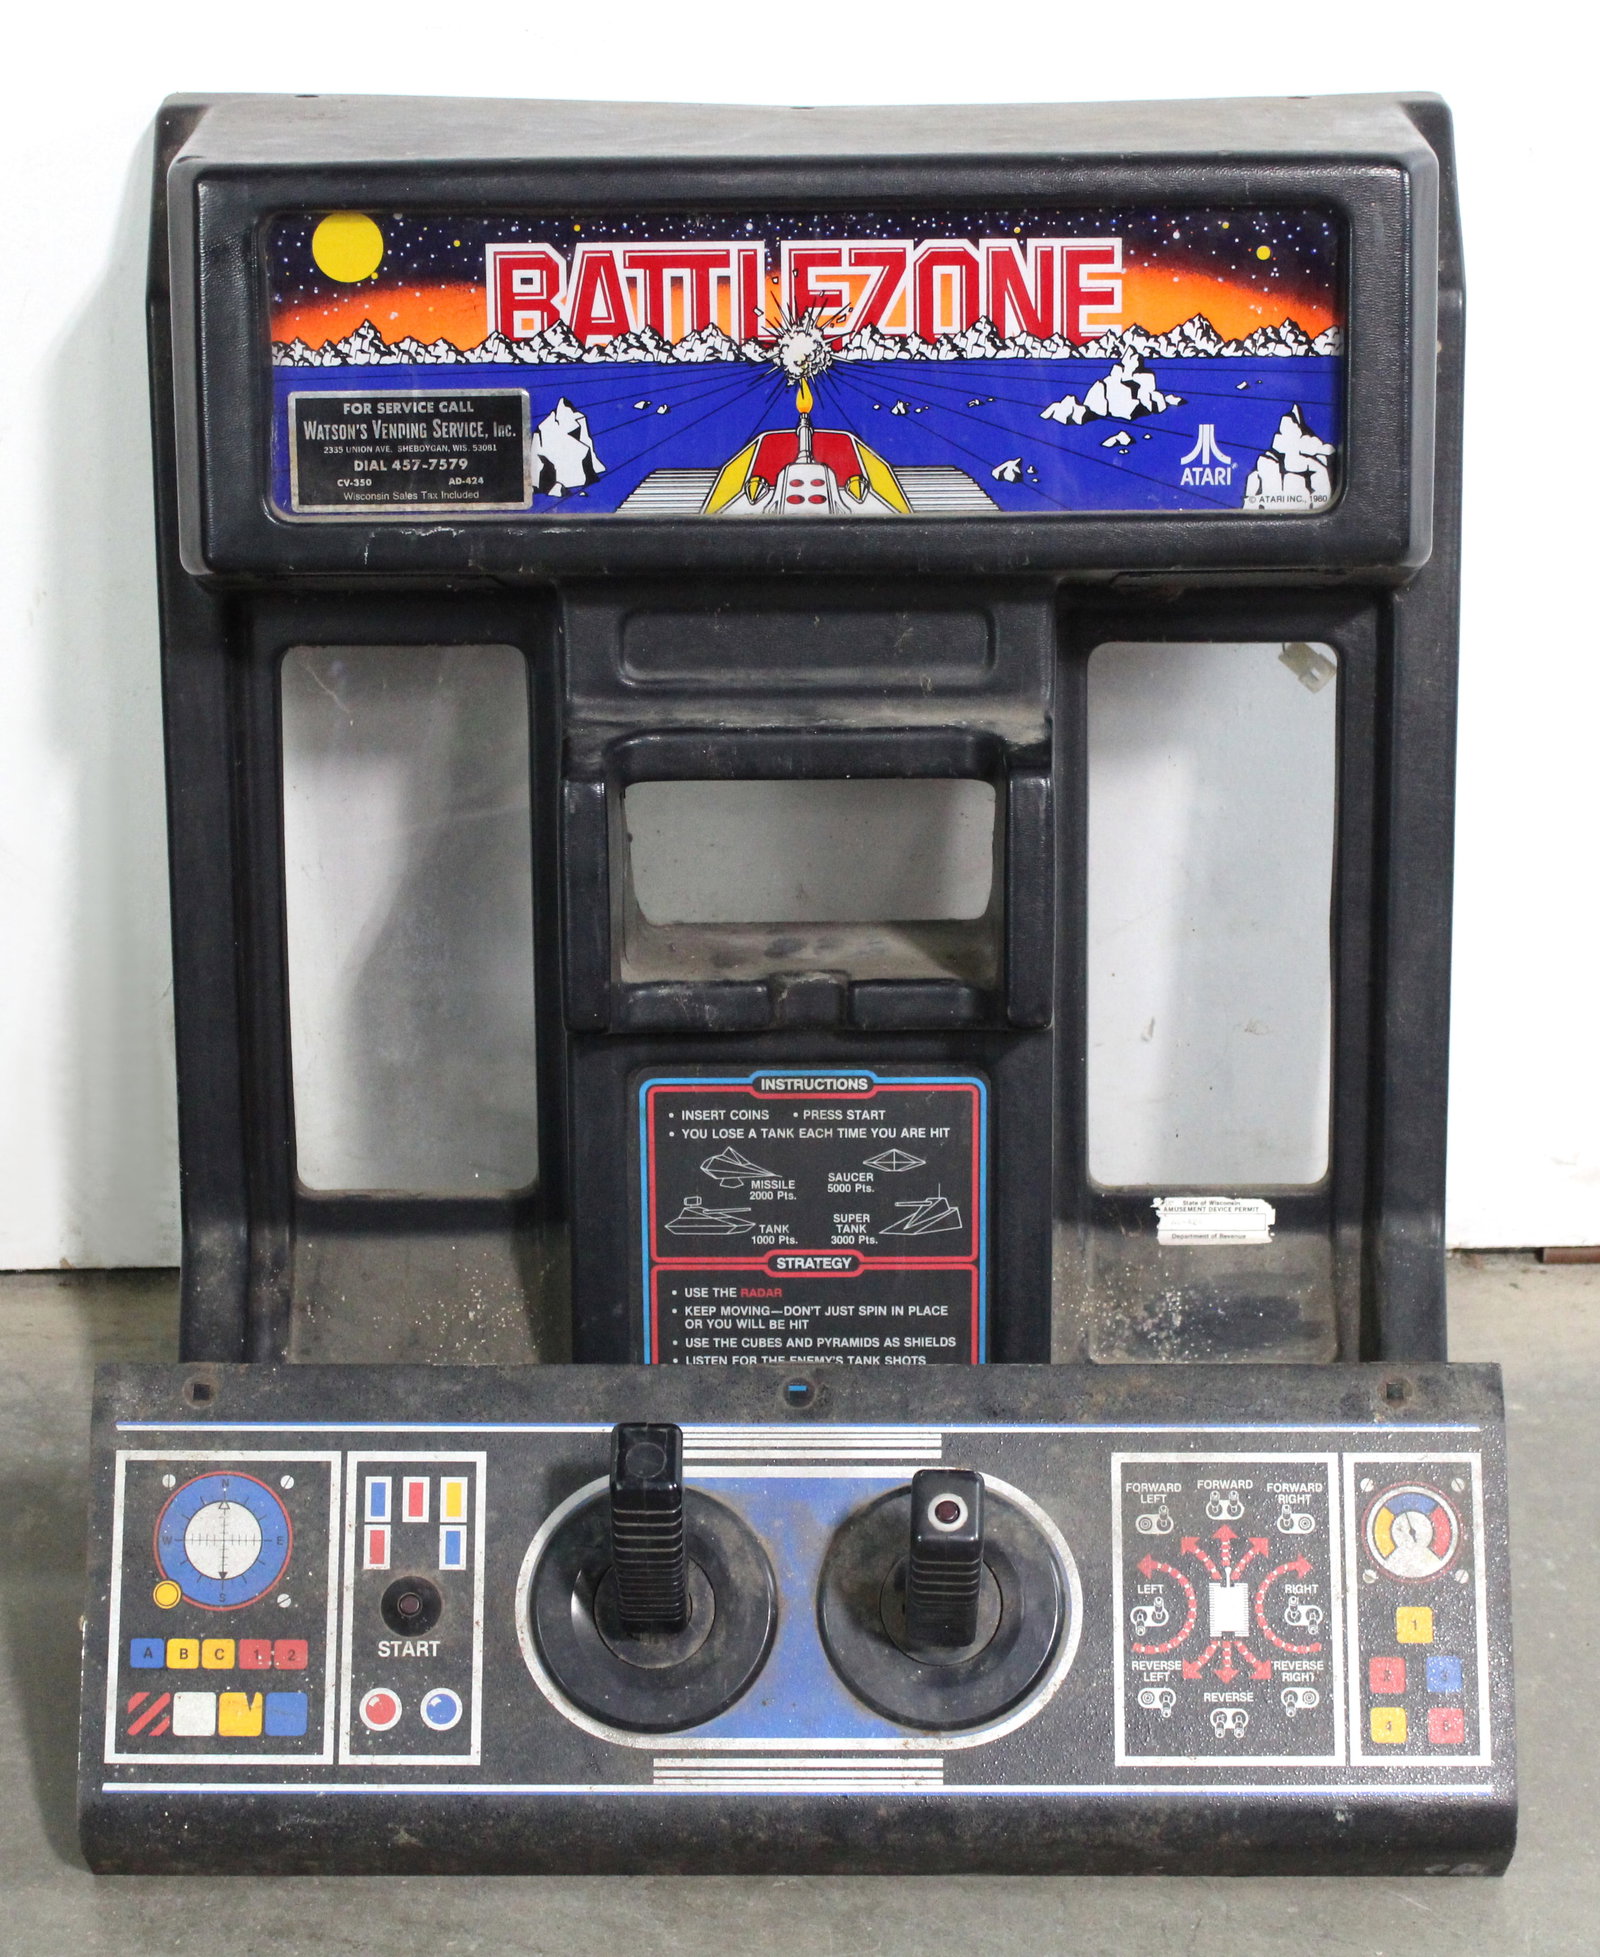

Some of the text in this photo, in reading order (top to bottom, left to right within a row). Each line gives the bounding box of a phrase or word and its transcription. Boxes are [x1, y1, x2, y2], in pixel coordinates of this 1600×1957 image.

[485, 238, 1123, 349] BATTLEZONE
[343, 401, 474, 414] FOR SERVICE CALL
[372, 419, 427, 439] VENDING
[324, 446, 344, 454] 2335
[354, 458, 468, 471] DIAL 457-7579
[448, 477, 484, 485] AD-424
[1180, 467, 1231, 485] ATARI
[344, 491, 479, 501] Wisconsin Sales Tax Included
[761, 1079, 868, 1091] INSTRUCTIONS
[681, 1109, 769, 1120] INSERT COINS
[803, 1109, 886, 1120] PRESS START
[682, 1127, 950, 1139] YOU LOSE A TANK EACH TIME YOU ARE HIT
[828, 1172, 874, 1182] SAUCER
[751, 1180, 795, 1190] MISSILE
[827, 1183, 874, 1193] 5000 Pts.
[750, 1190, 796, 1201] 2000 Pts.
[833, 1214, 870, 1223] SUPER
[759, 1224, 789, 1234] TANK
[836, 1224, 866, 1234] TANK
[752, 1235, 798, 1245] 1000 Pts.
[831, 1234, 878, 1244] 3000 Pts.
[776, 1257, 851, 1270] STRATEGY
[685, 1288, 782, 1298] USE THE RADAR
[685, 1306, 716, 1316] KEEP
[824, 1306, 854, 1316] JUST
[858, 1305, 887, 1316] SPIN
[891, 1305, 904, 1315] IN
[908, 1305, 948, 1316] PLACE
[685, 1319, 809, 1330] OR YOU WILL BE HIT
[685, 1336, 956, 1348] USE THE CUBES AND PYRAMIDS AS SHIELDS
[686, 1356, 727, 1365] LISTEN
[732, 1356, 756, 1364] FOR
[847, 1356, 880, 1365] TANK
[885, 1356, 926, 1364] SHOTS
[222, 1479, 229, 1488] N
[1126, 1483, 1182, 1492] FORWARD
[1197, 1480, 1253, 1489] FORWARD
[1266, 1483, 1322, 1492] FORWARD
[1140, 1495, 1166, 1504] LEFT
[1278, 1494, 1312, 1504] RIGHT
[162, 1536, 173, 1545] W
[277, 1536, 283, 1545] E
[1138, 1585, 1164, 1594] LEFT
[1285, 1584, 1318, 1594] RIGHT
[219, 1593, 226, 1603] S
[378, 1640, 441, 1657] START
[143, 1647, 153, 1659] A
[179, 1648, 189, 1660] B
[215, 1648, 225, 1661] C
[288, 1648, 296, 1661] 2
[1132, 1661, 1182, 1670] REVERSE
[1273, 1661, 1324, 1670] REVERSE
[1144, 1672, 1170, 1682] LEFT
[1282, 1672, 1315, 1682] RIGHT
[1204, 1692, 1254, 1702] REVERSE
